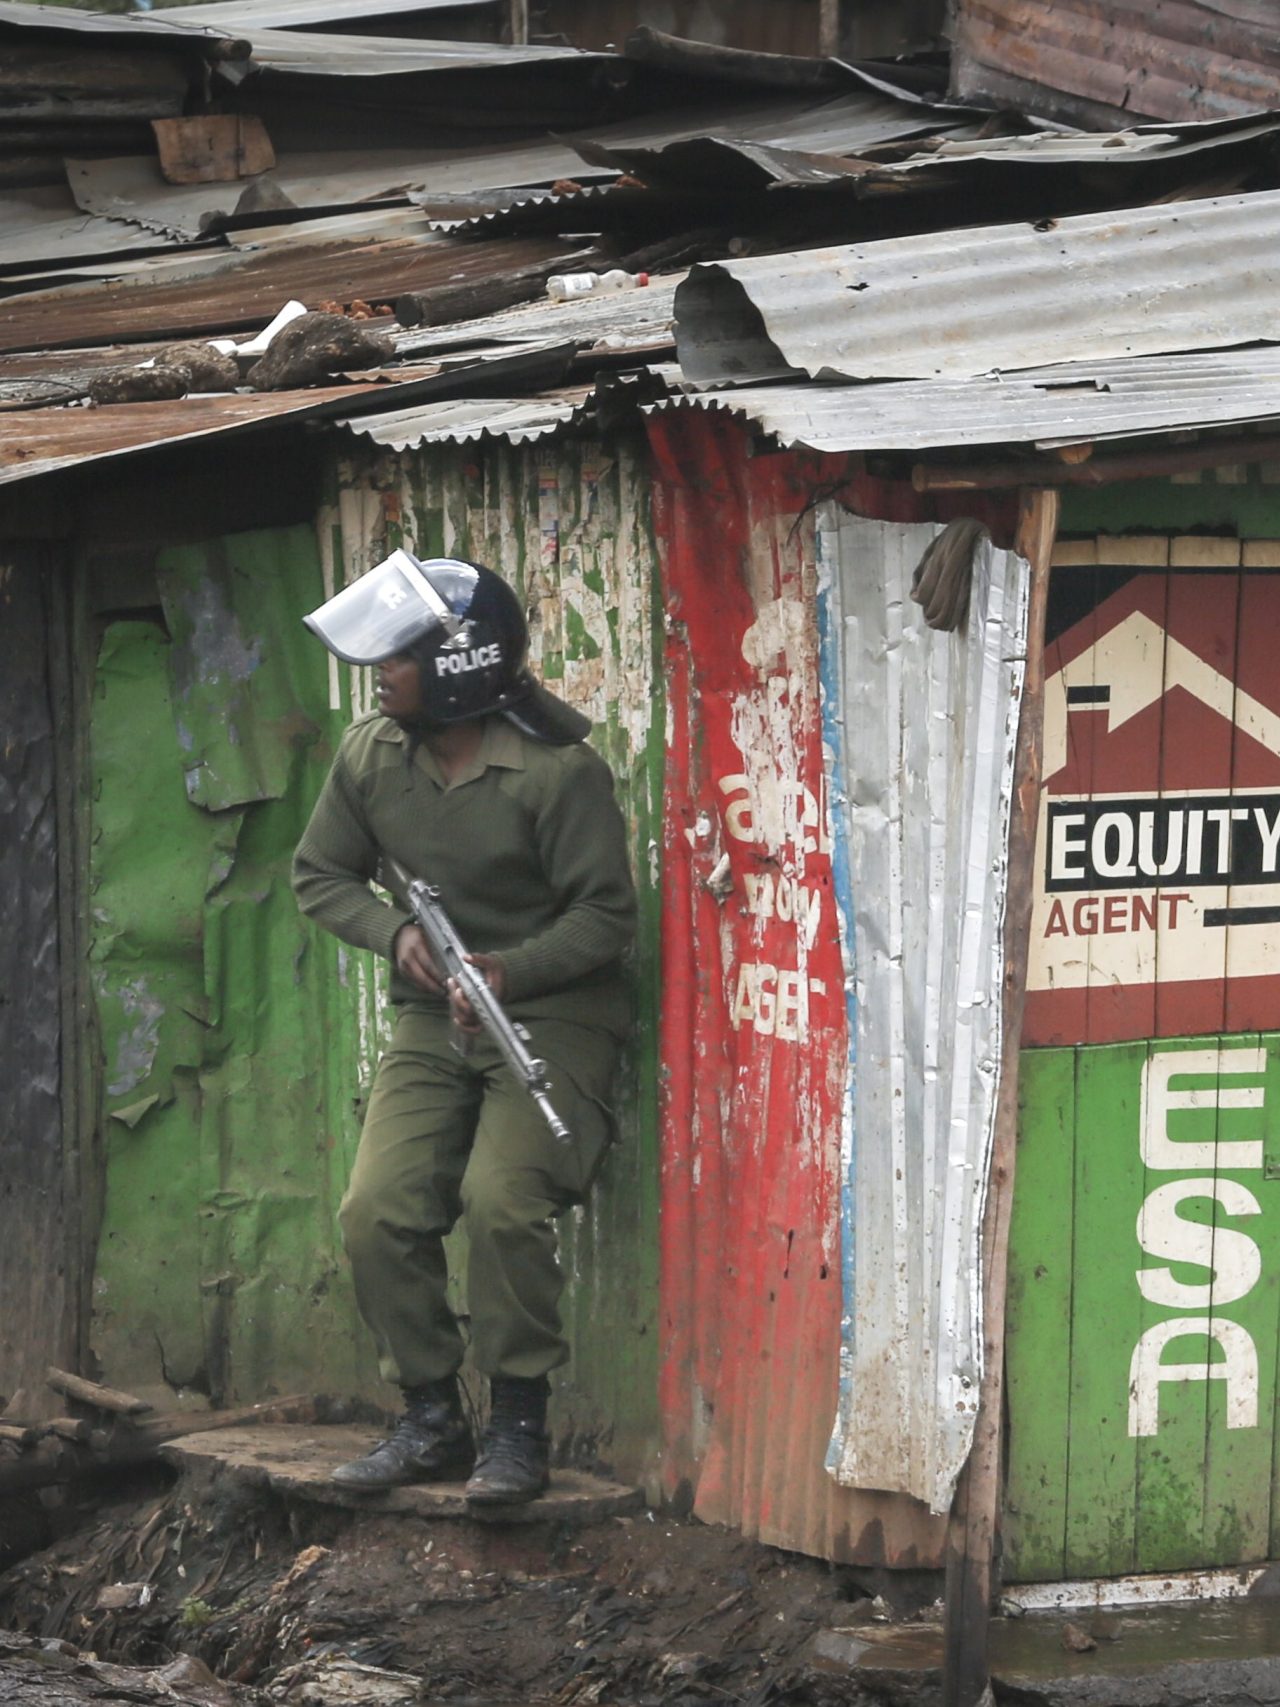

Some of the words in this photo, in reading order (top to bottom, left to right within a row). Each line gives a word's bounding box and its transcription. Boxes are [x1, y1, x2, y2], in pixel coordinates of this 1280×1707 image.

[435, 643, 502, 677] POLICE
[1043, 893, 1190, 938] AGENT
[1128, 1047, 1267, 1437] ESA
